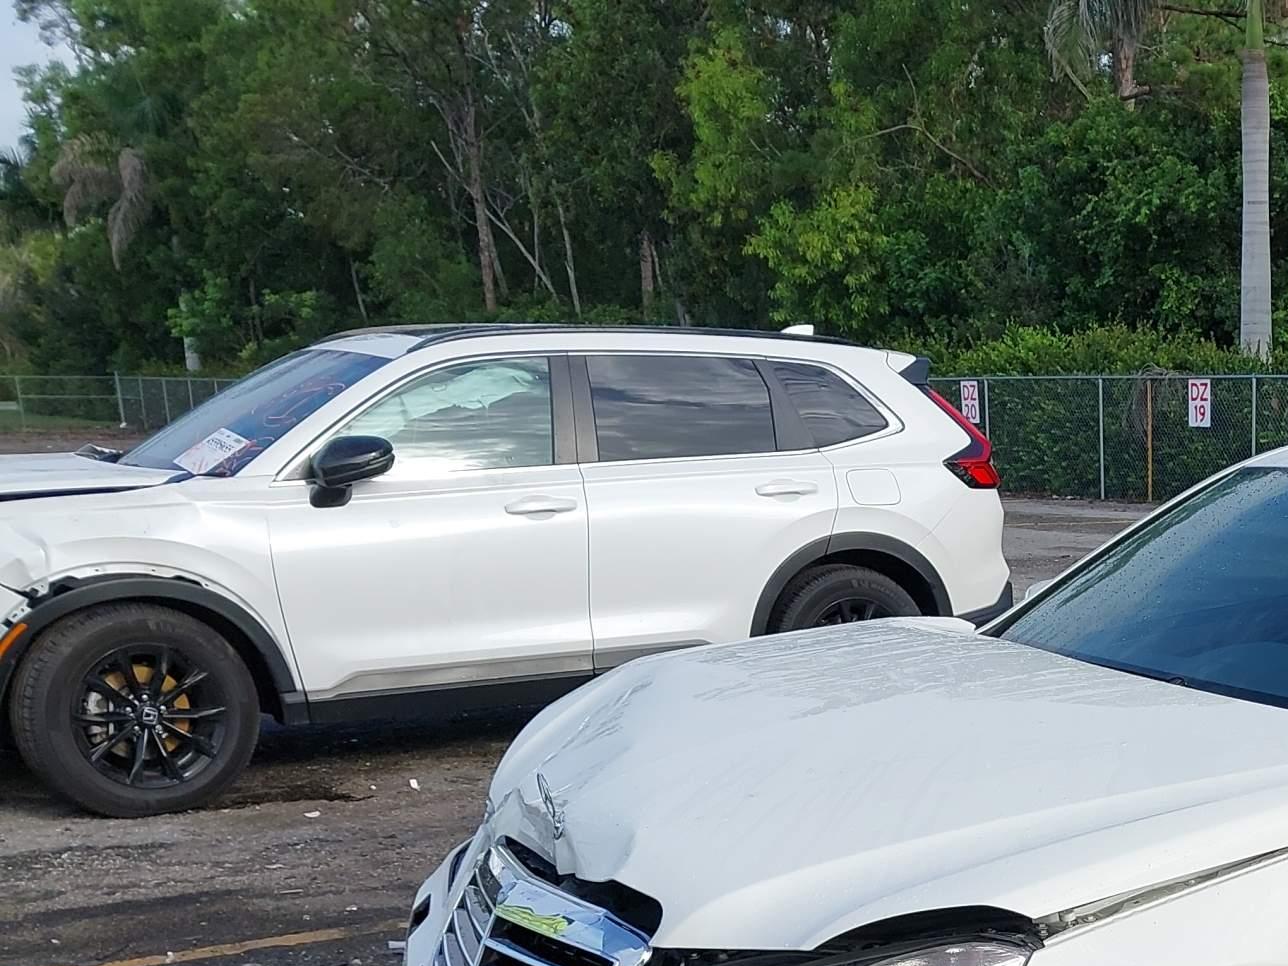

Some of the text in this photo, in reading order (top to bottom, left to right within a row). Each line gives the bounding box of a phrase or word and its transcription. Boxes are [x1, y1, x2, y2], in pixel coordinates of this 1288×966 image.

[963, 384, 977, 402] DZ
[1191, 382, 1209, 402] DZ
[964, 403, 977, 420] 20
[1194, 404, 1206, 423] 19
